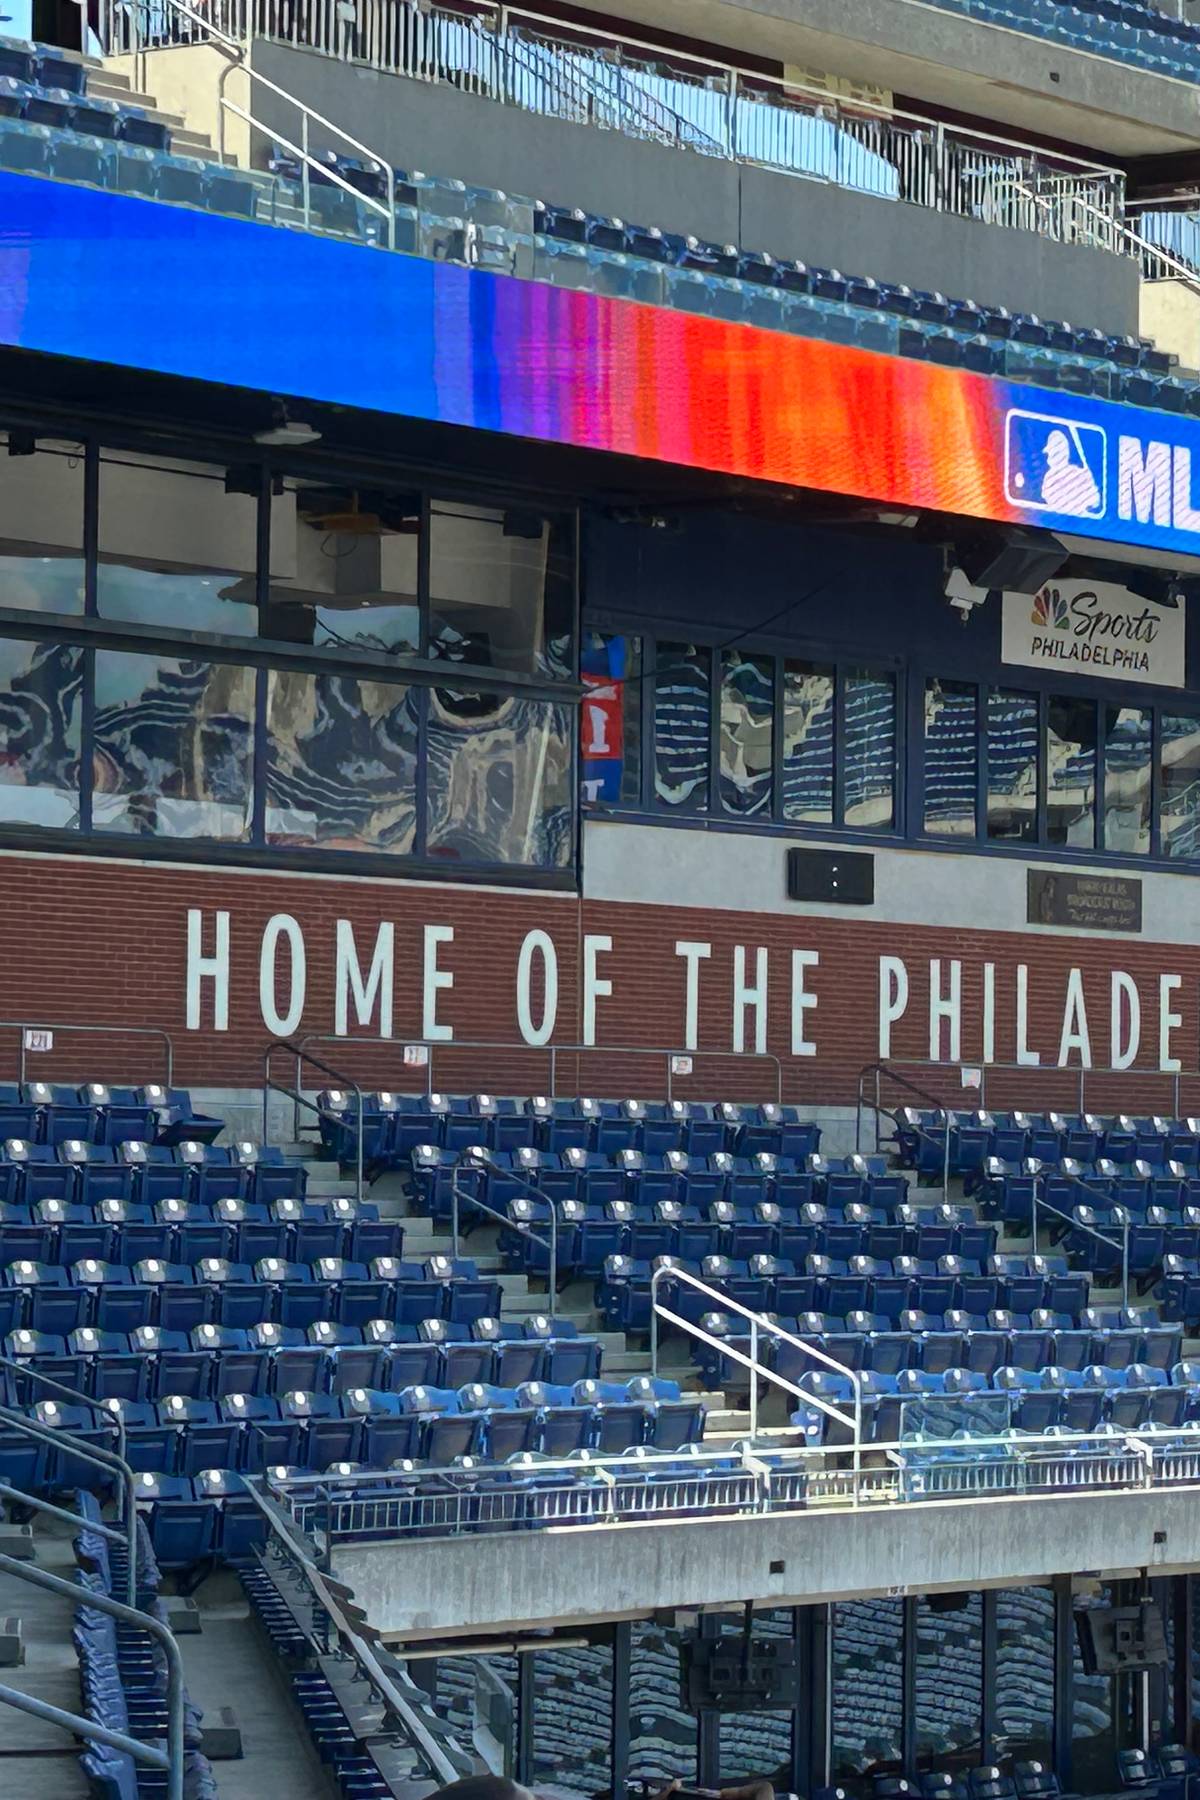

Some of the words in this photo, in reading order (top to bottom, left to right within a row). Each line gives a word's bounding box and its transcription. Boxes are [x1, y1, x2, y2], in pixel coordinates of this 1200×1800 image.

[1069, 591, 1162, 643] Sports
[1031, 636, 1150, 672] PHILADELPHIA
[186, 909, 454, 1041] HOME
[517, 929, 613, 1046] OF
[675, 941, 819, 1056] THE
